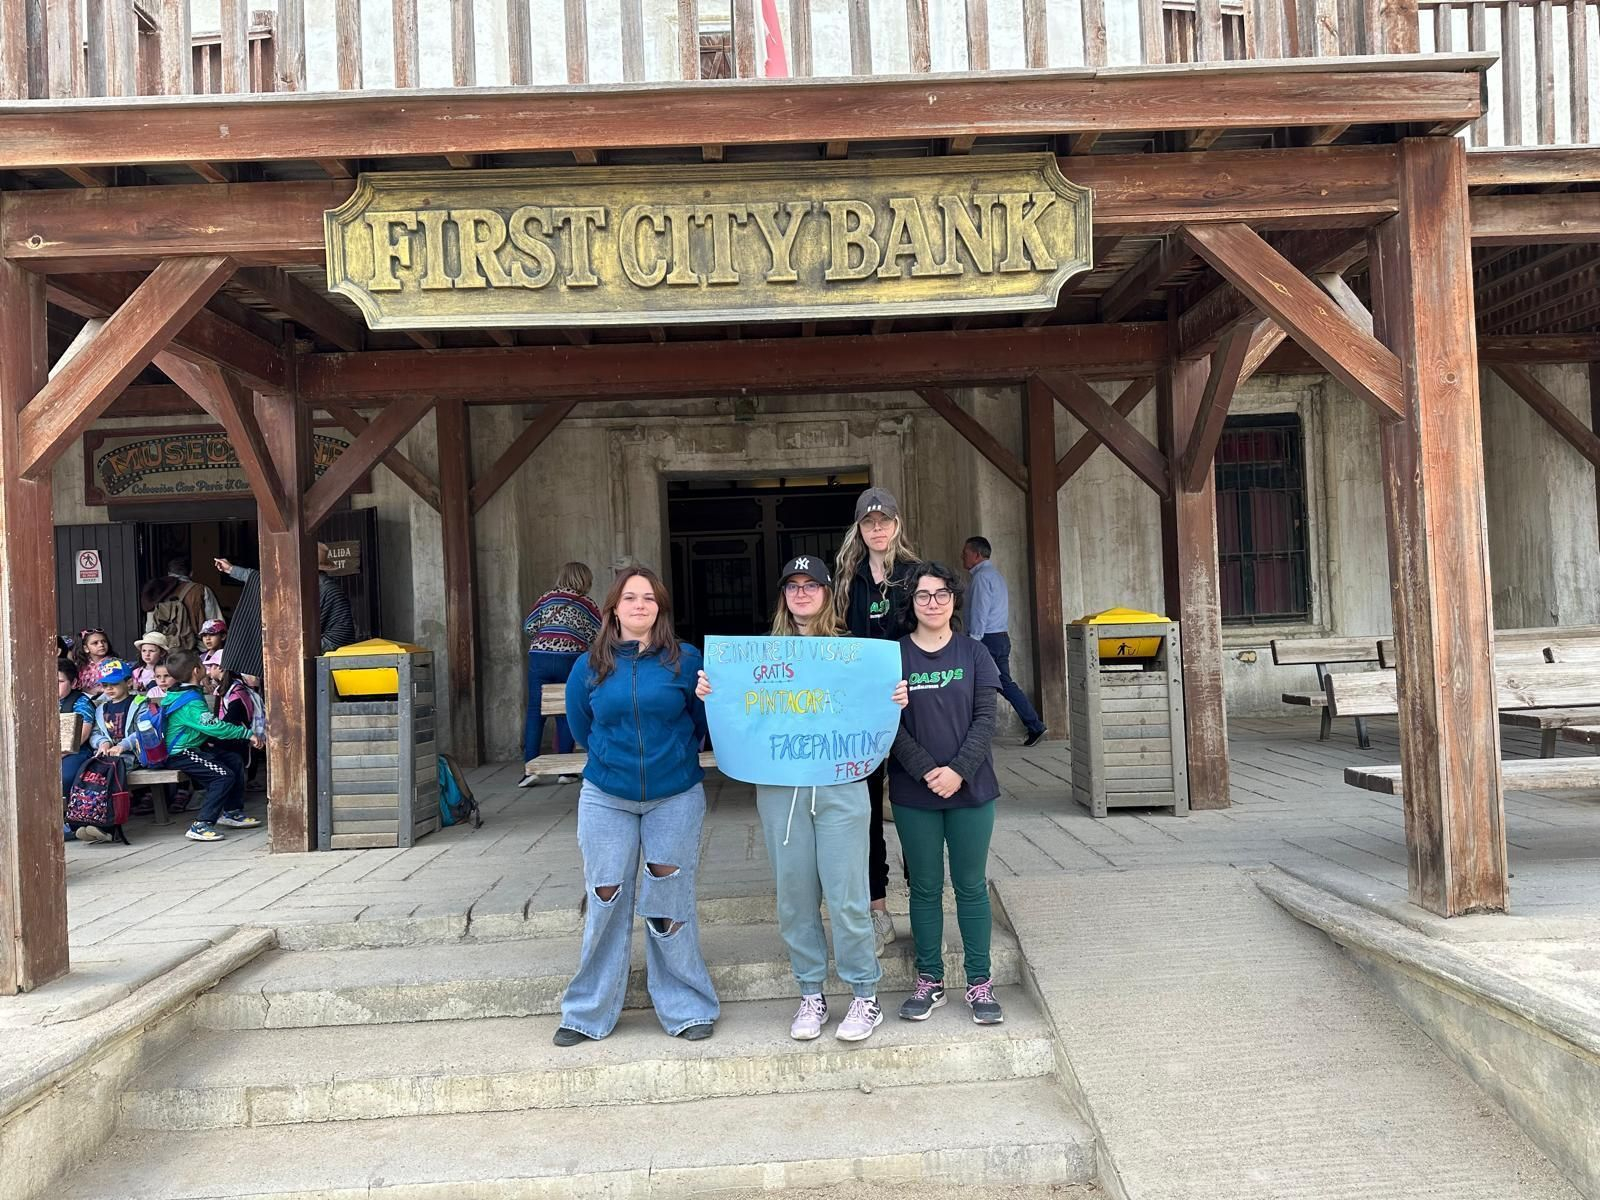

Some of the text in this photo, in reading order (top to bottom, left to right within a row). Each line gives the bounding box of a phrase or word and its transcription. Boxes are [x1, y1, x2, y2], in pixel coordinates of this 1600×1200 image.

[365, 191, 1058, 291] FIRST CITY BANK
[109, 437, 229, 477] MUSEO
[328, 548, 351, 558] ALIDA
[333, 560, 346, 568] XIT
[753, 662, 794, 681] GRATIS
[744, 688, 846, 714] PINTACARAS
[769, 730, 892, 761] FACEPAINTING
[835, 758, 874, 779] FREE
